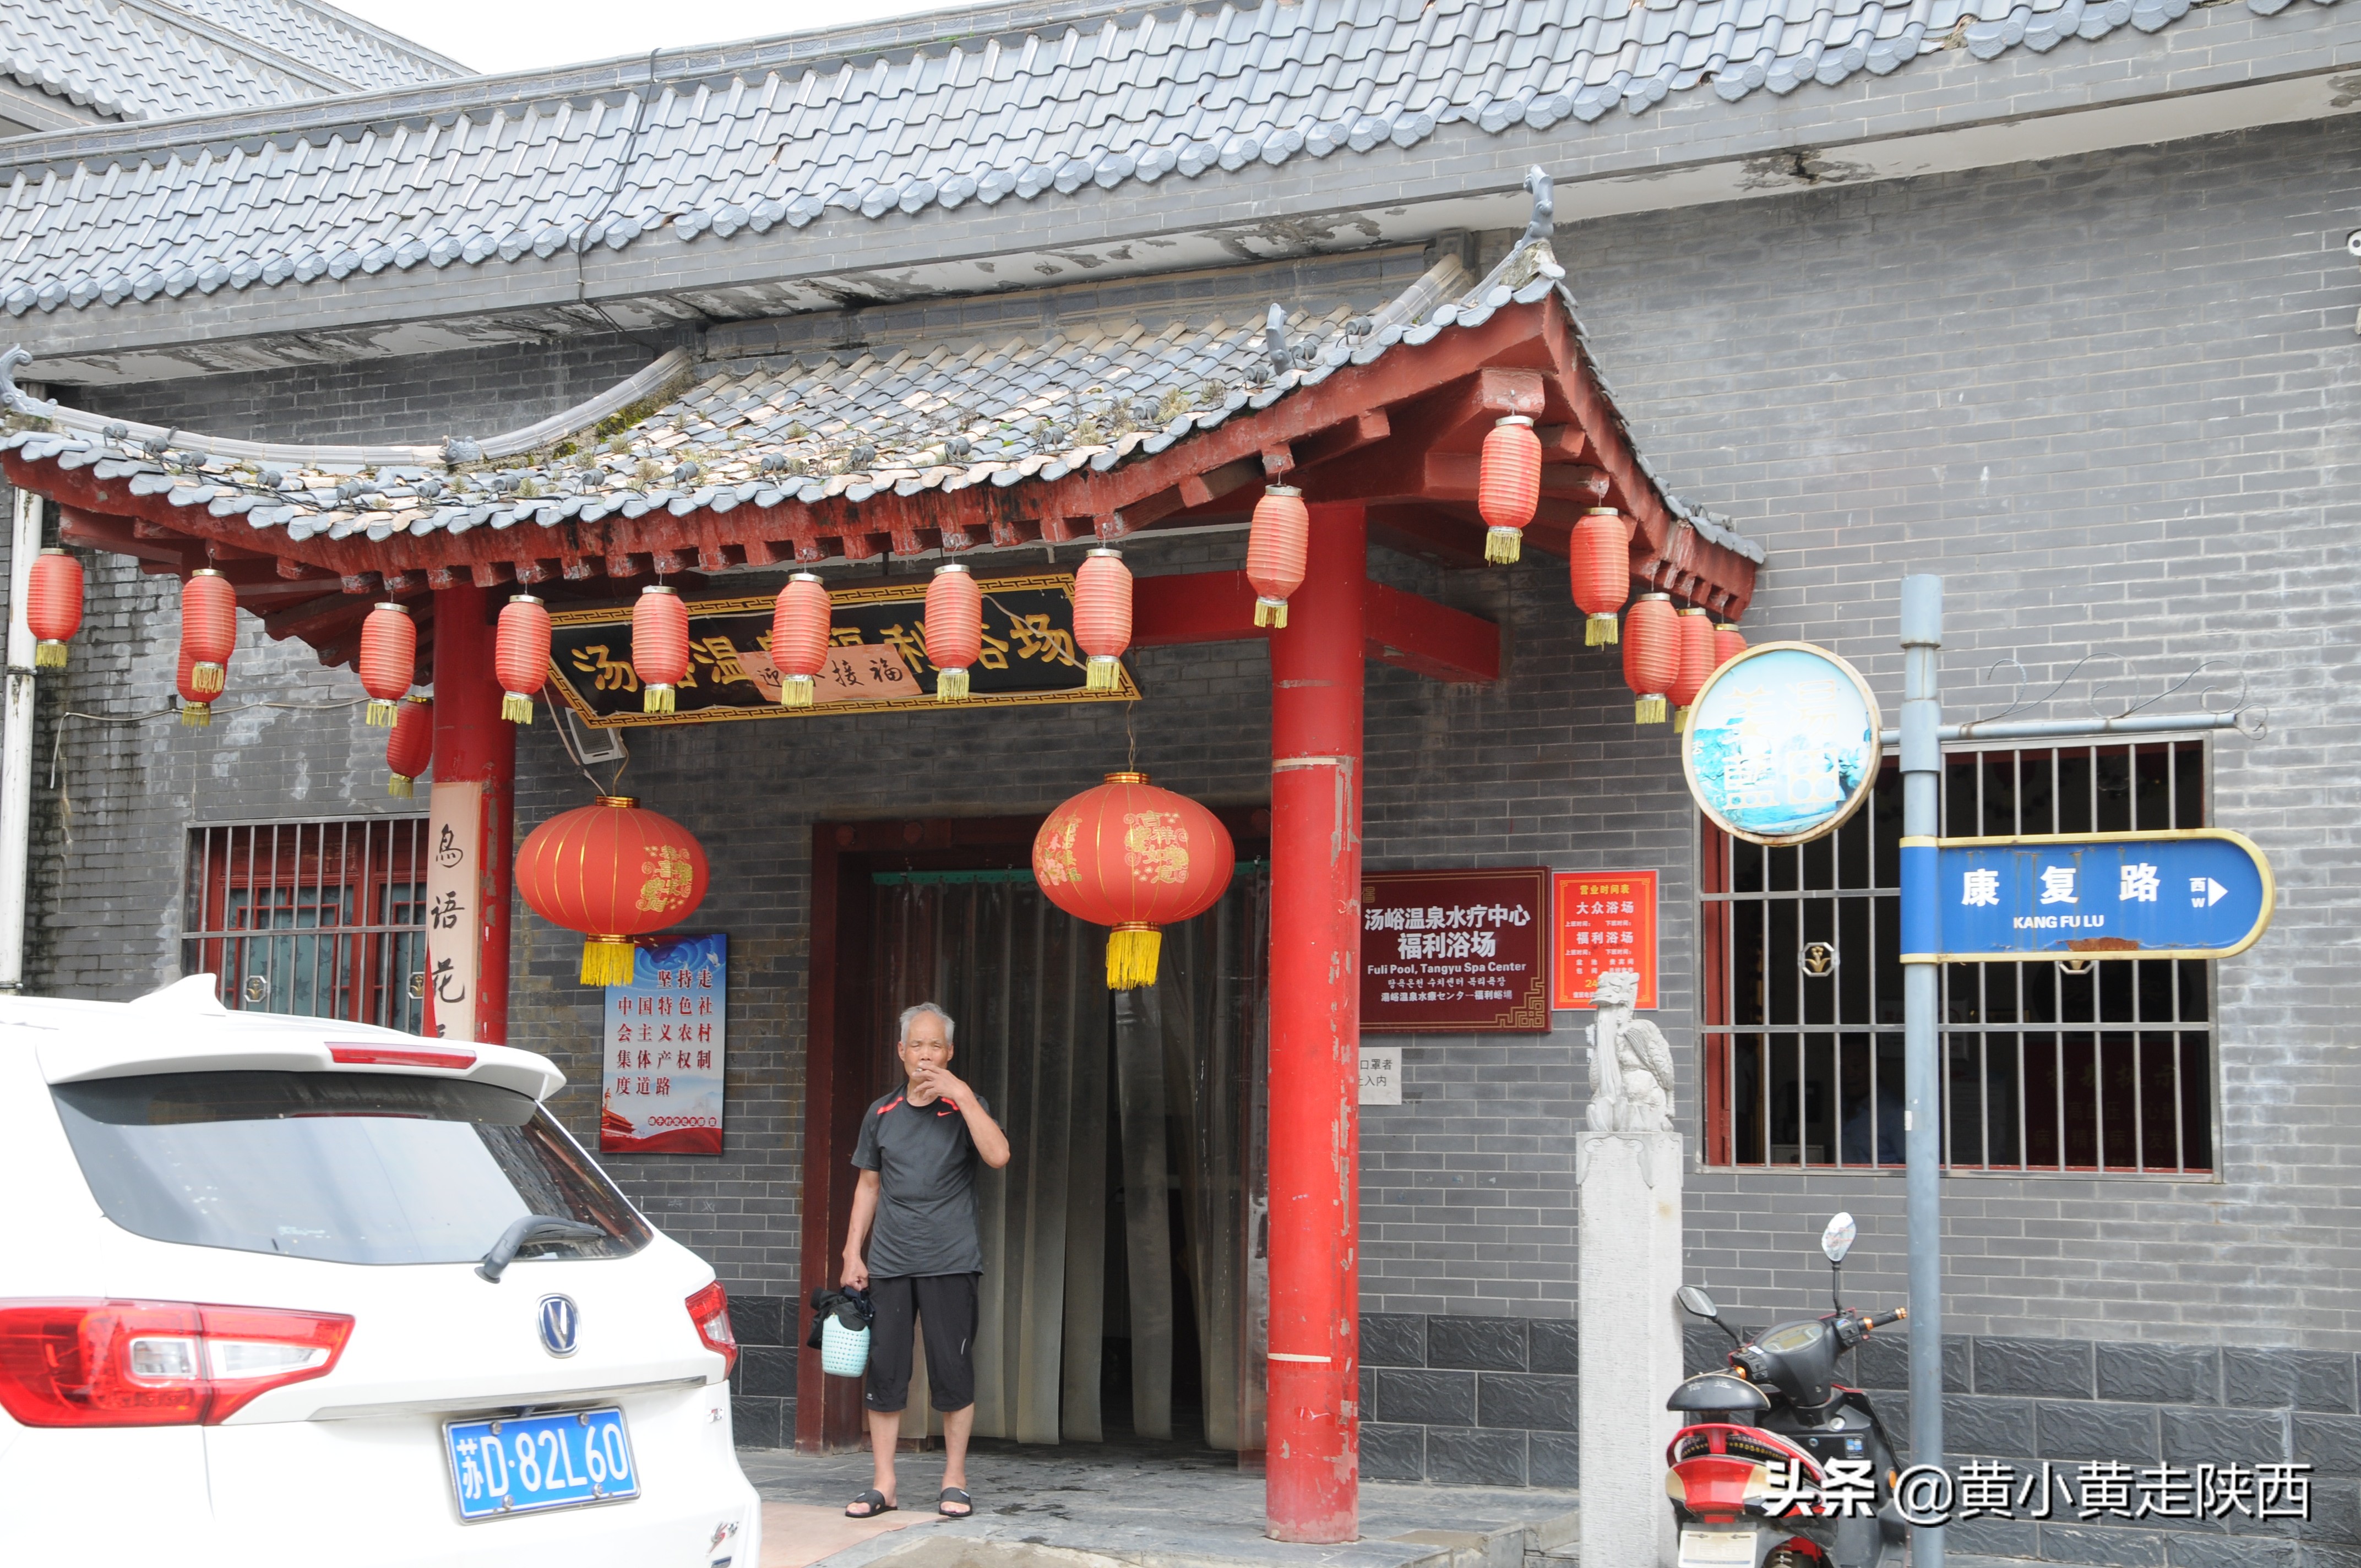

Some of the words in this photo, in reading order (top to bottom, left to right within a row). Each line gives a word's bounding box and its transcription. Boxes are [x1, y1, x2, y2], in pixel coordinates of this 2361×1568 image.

[757, 657, 902, 688] 迎接福
[1136, 810, 1177, 884] 吉祥如意
[1580, 884, 1630, 895] 营业时间表
[1961, 862, 2161, 907] 康复路
[2189, 877, 2206, 893] 西
[1576, 901, 1635, 915] 大众浴场
[2191, 897, 2206, 908] W
[1364, 903, 1531, 931] 汤峪温泉水疗中心
[2013, 916, 2058, 929] KANG
[2060, 916, 2082, 928] FU
[2083, 914, 2104, 928] LU
[431, 824, 465, 1039] 鸟语花
[1576, 931, 1634, 945] 福利浴场
[1397, 930, 1497, 960] 福利浴场
[1367, 965, 1388, 975] Fuli
[1390, 964, 1418, 976] Pool,
[1419, 963, 1462, 976] Tangyu
[1464, 962, 1486, 974] Spa
[1487, 961, 1527, 972] Center
[657, 969, 713, 989] 坚持走
[618, 995, 714, 1016] 中国特色社
[617, 1022, 712, 1043] 会主义农村
[616, 1049, 712, 1070] 集体产权制
[615, 1076, 671, 1096] 度道路
